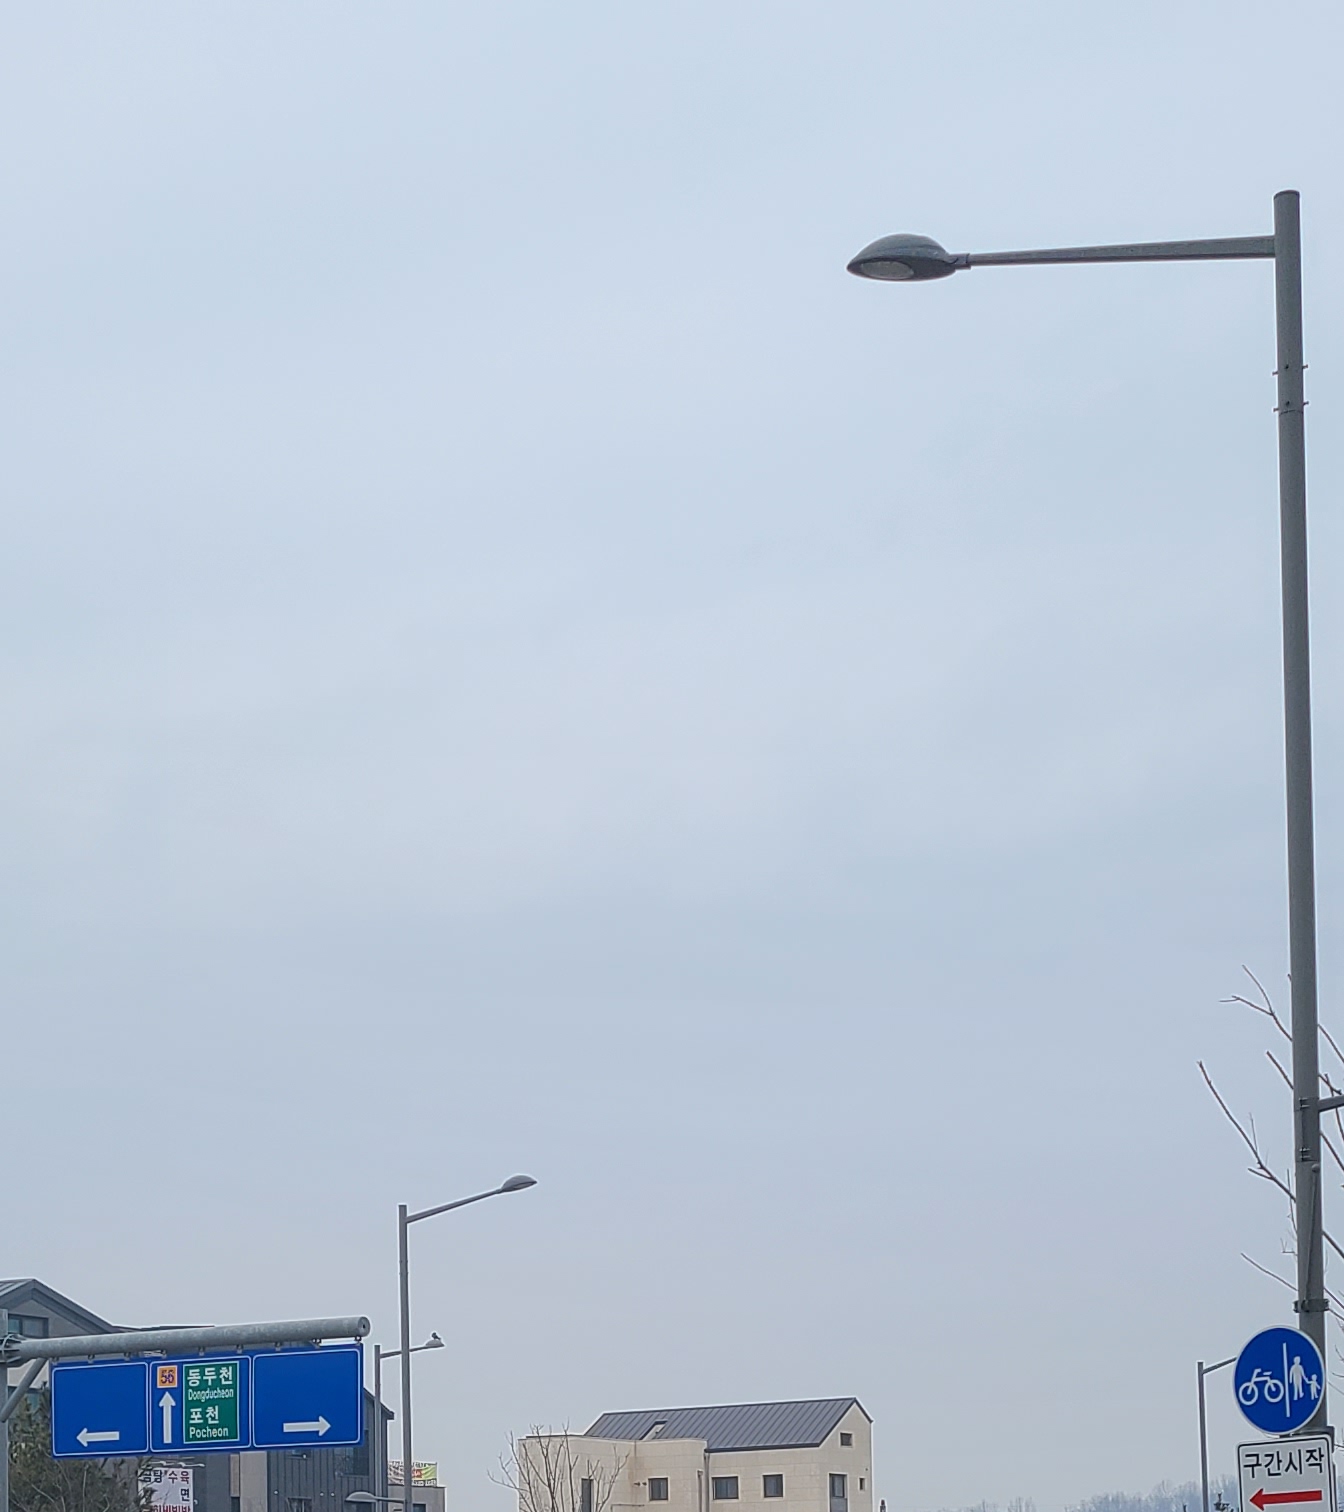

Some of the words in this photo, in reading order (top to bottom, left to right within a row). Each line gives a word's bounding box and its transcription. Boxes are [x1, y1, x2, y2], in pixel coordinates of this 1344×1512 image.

[160, 1369, 175, 1384] 56
[187, 1366, 233, 1387] 동두천
[188, 1387, 234, 1403] Dongducheon
[189, 1405, 219, 1424] 포천
[189, 1427, 229, 1439] Pocheon
[1243, 1447, 1325, 1479] 구간시작
